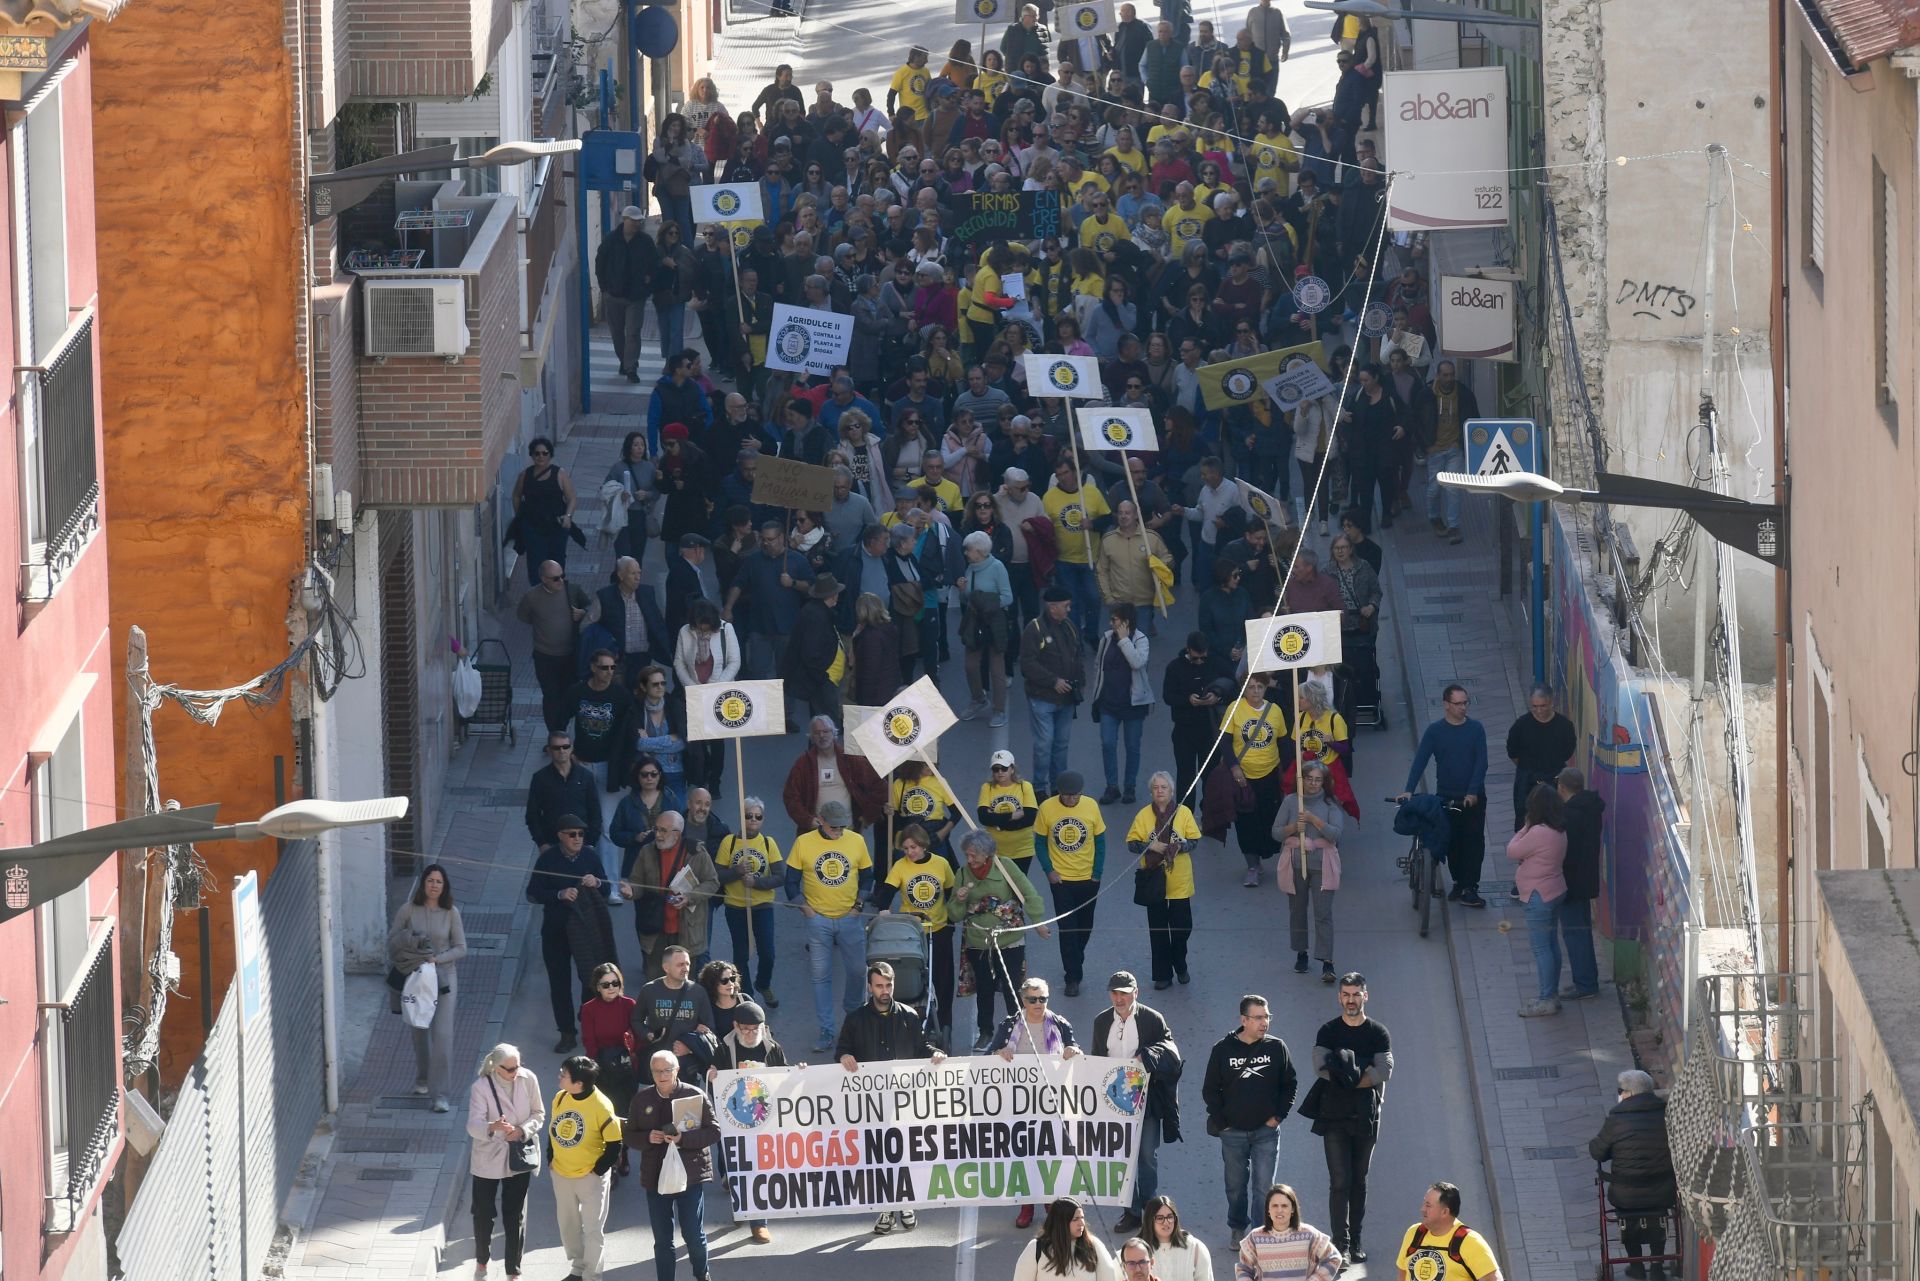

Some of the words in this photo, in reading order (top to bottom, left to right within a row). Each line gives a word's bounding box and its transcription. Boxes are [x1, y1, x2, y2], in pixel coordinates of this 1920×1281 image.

[1474, 185, 1502, 193] estudio
[972, 193, 1020, 212] FIRMAS
[1475, 193, 1502, 209] 122
[954, 210, 1017, 241] RECOGIDA
[787, 315, 832, 329] AGRIDULCE
[835, 323, 840, 331] II
[813, 331, 834, 339] CONTRA
[805, 360, 823, 369] AQUÍ
[1274, 630, 1285, 648] STOP
[1289, 626, 1310, 645] BIOGAS
[1280, 649, 1307, 661] MOLINA
[715, 694, 726, 713] STOP
[730, 691, 751, 713] BIOGAS
[721, 716, 748, 727] MOLINA
[884, 719, 892, 737] STOP
[890, 708, 917, 720] BIOGAS
[898, 726, 920, 744] MOLINA
[1054, 821, 1064, 837] STOP
[1068, 819, 1086, 837] BIOGAS
[1059, 842, 1082, 851] MOLINA
[815, 856, 826, 872] STOP
[830, 853, 849, 871] BIOGAS
[821, 876, 848, 885] MOLINA
[907, 878, 917, 895] STOP
[921, 875, 940, 893] BIOGAS
[913, 898, 937, 908] MOLINA
[656, 999, 673, 1008] FIND
[841, 1069, 938, 1092] ASOCIACIÓN
[945, 1069, 965, 1086] DE
[969, 1067, 1039, 1085] VECINOS
[777, 1095, 836, 1128] POR
[844, 1092, 884, 1125] UN
[895, 1086, 1002, 1121] PUEBLO
[1012, 1084, 1098, 1116] DIGNO
[553, 1113, 567, 1128] STOP
[570, 1112, 583, 1135] BIOGAS
[724, 1136, 753, 1172] EL
[757, 1129, 860, 1171] BIOGÁS
[865, 1127, 904, 1165] NO
[909, 1125, 939, 1162] ES
[943, 1120, 1057, 1159] ENERGÍA
[1062, 1121, 1134, 1158] LIMPI
[730, 1175, 748, 1212] SI
[753, 1166, 916, 1211] CONTAMINA
[927, 1161, 1031, 1200] AGUA
[1036, 1160, 1062, 1196] Y
[1409, 1252, 1423, 1270] STOP
[1428, 1251, 1444, 1274] BIOGAS
